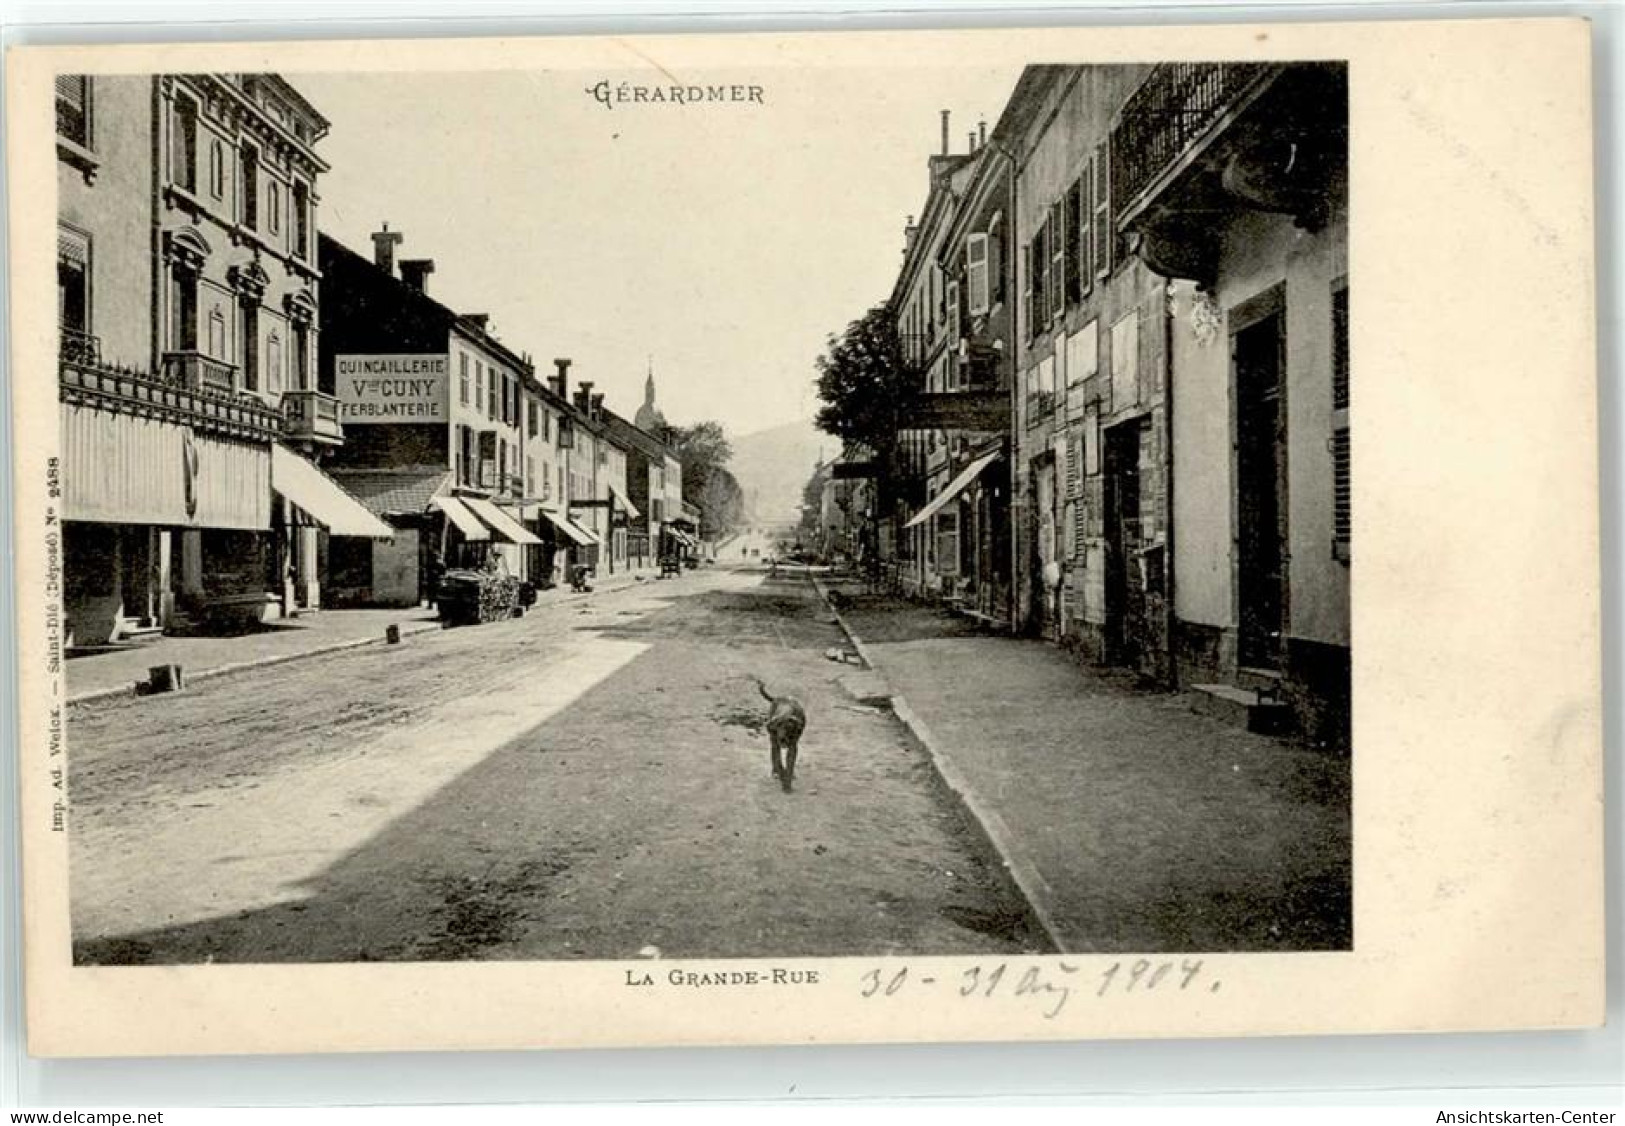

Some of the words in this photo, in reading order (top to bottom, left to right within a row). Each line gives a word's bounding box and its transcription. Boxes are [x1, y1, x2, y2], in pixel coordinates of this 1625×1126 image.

[585, 80, 764, 109] GÉRARDMER
[340, 361, 444, 374] QUINCAILLERIE
[382, 380, 434, 396] CUNY
[342, 402, 439, 416] FERBLANTERIE
[861, 966, 908, 997] 30
[960, 963, 1006, 997] 31
